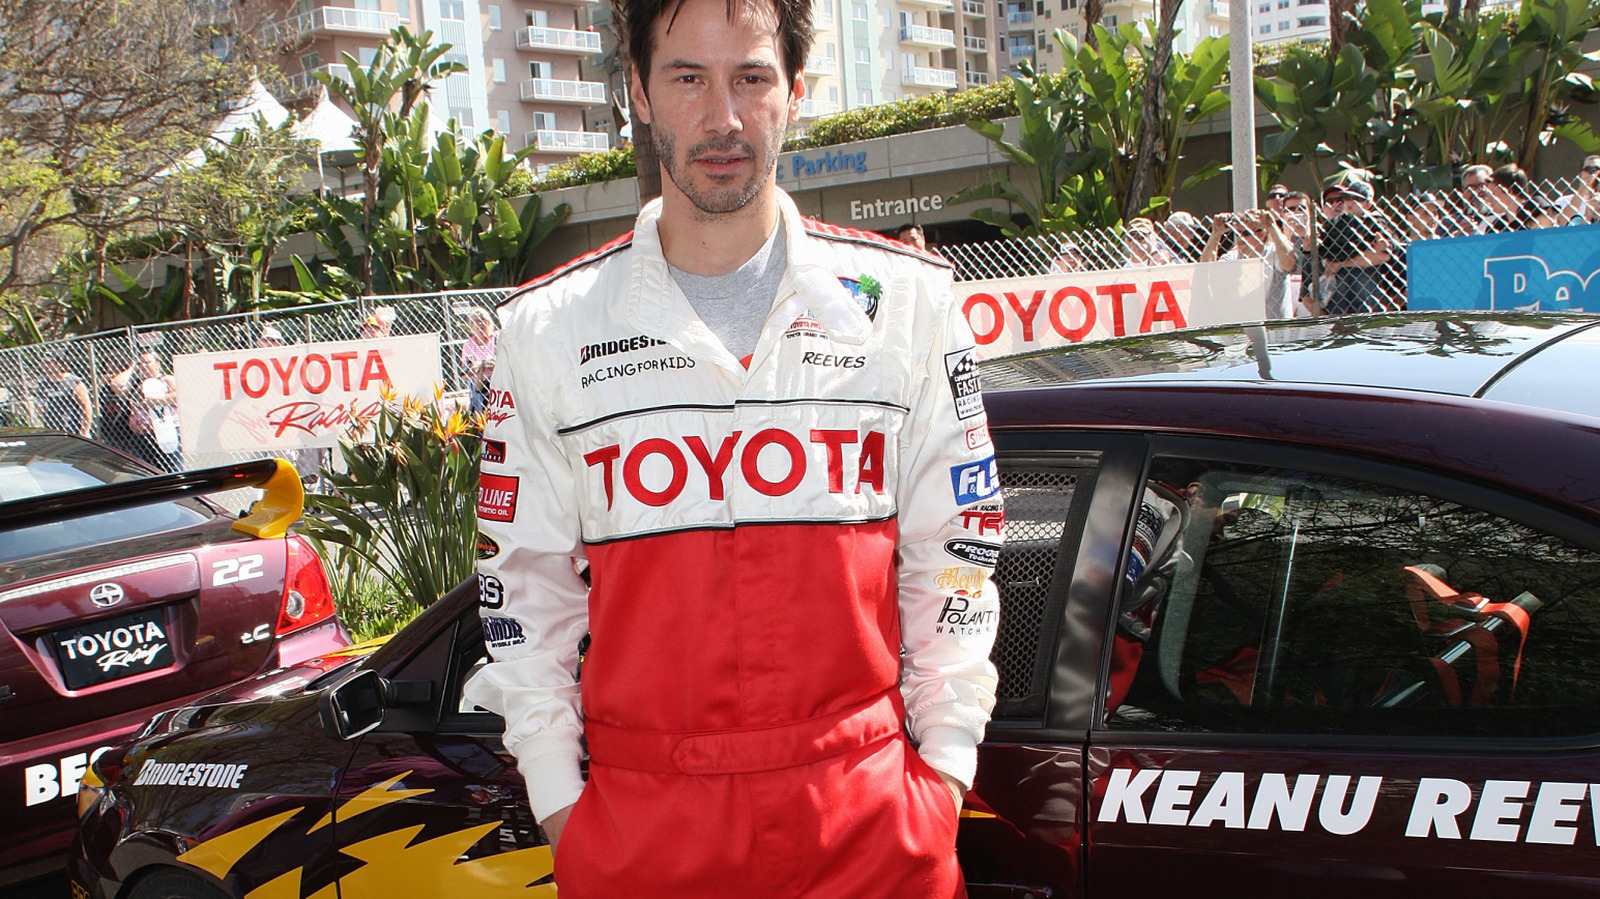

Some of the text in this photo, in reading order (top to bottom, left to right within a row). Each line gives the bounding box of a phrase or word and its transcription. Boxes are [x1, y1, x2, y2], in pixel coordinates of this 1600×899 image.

[792, 150, 867, 174] Parking
[851, 194, 943, 221] Entrance
[1484, 255, 1600, 312] Pe
[580, 334, 671, 366] BRIDGEST
[801, 351, 866, 369] REEVES
[213, 349, 394, 401] TOYOTA
[581, 356, 696, 389] RACING FOR KIDS
[583, 427, 886, 513] TOYOTA
[484, 488, 514, 507] LINE
[212, 553, 264, 587] 22
[60, 621, 166, 660] TOYOTA
[95, 643, 168, 673] Racing
[25, 746, 113, 807] BE
[132, 758, 248, 789] BRIDGESTONE
[1097, 768, 1600, 847] KEANU REE
